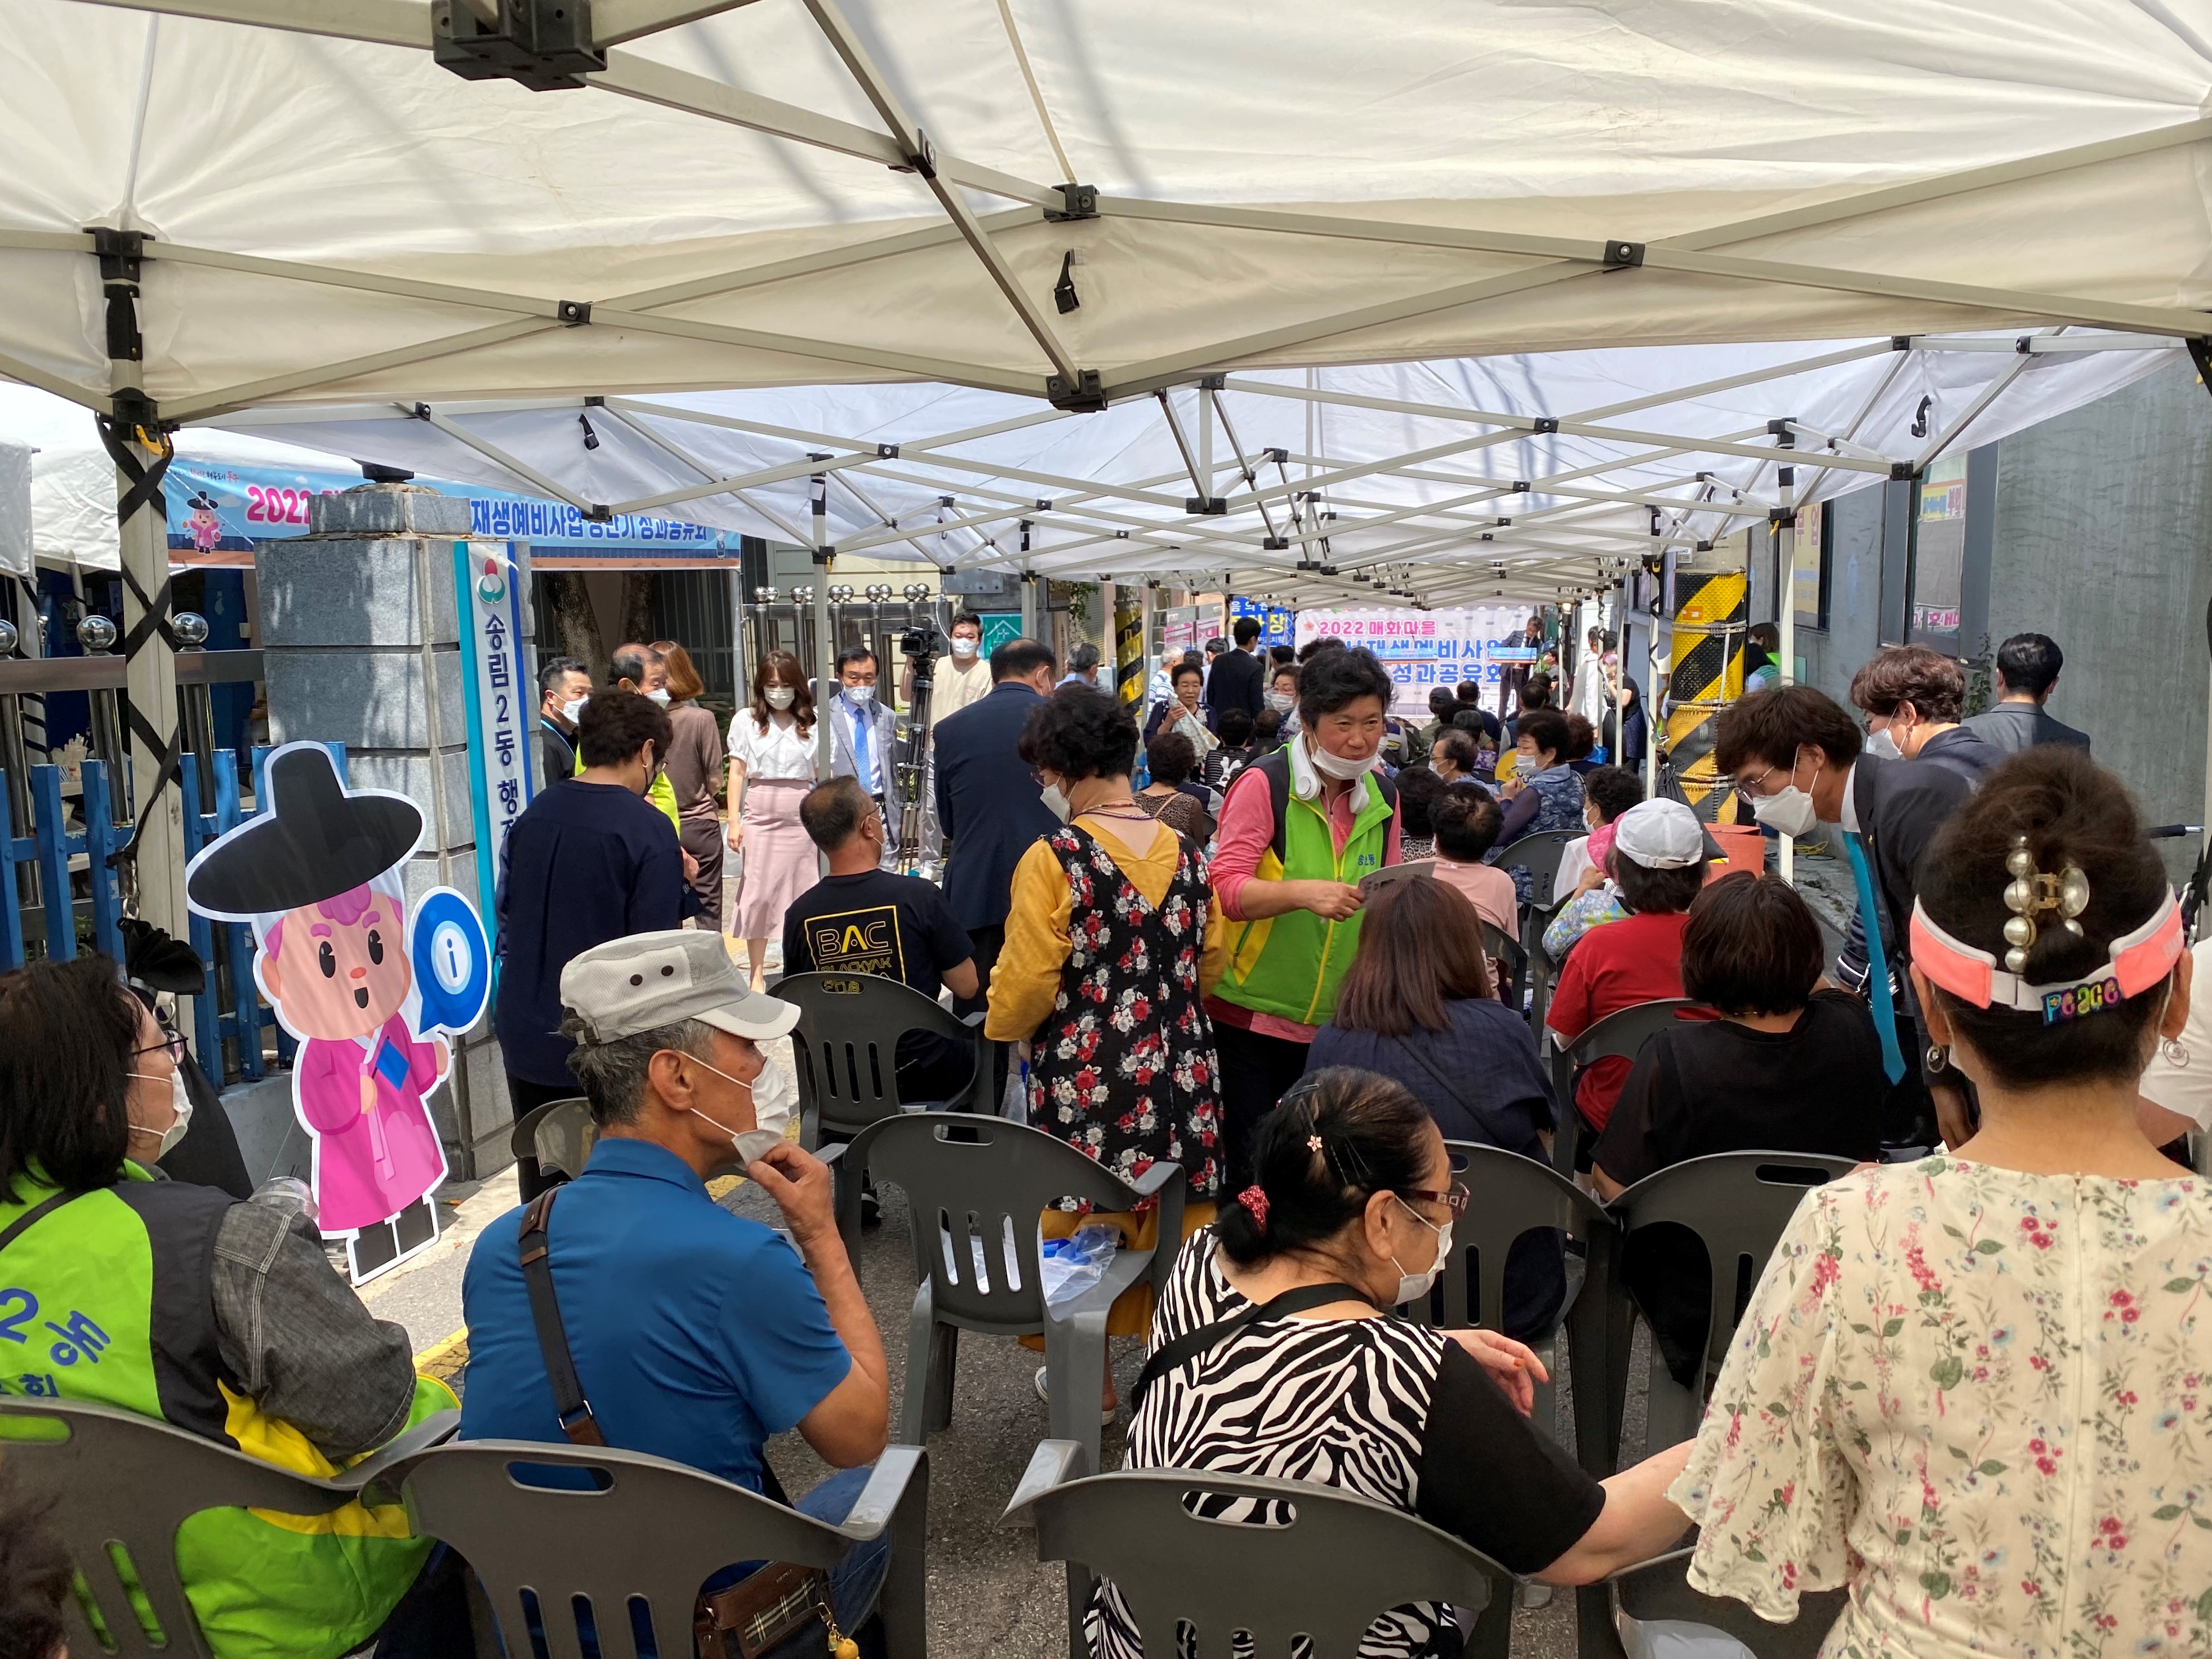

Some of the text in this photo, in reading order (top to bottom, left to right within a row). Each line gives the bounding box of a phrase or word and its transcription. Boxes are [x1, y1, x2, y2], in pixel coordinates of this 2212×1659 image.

[1319, 621, 1436, 635] 2022 매화마을
[816, 920, 889, 957] BAC
[2044, 978, 2120, 1022] Peace
